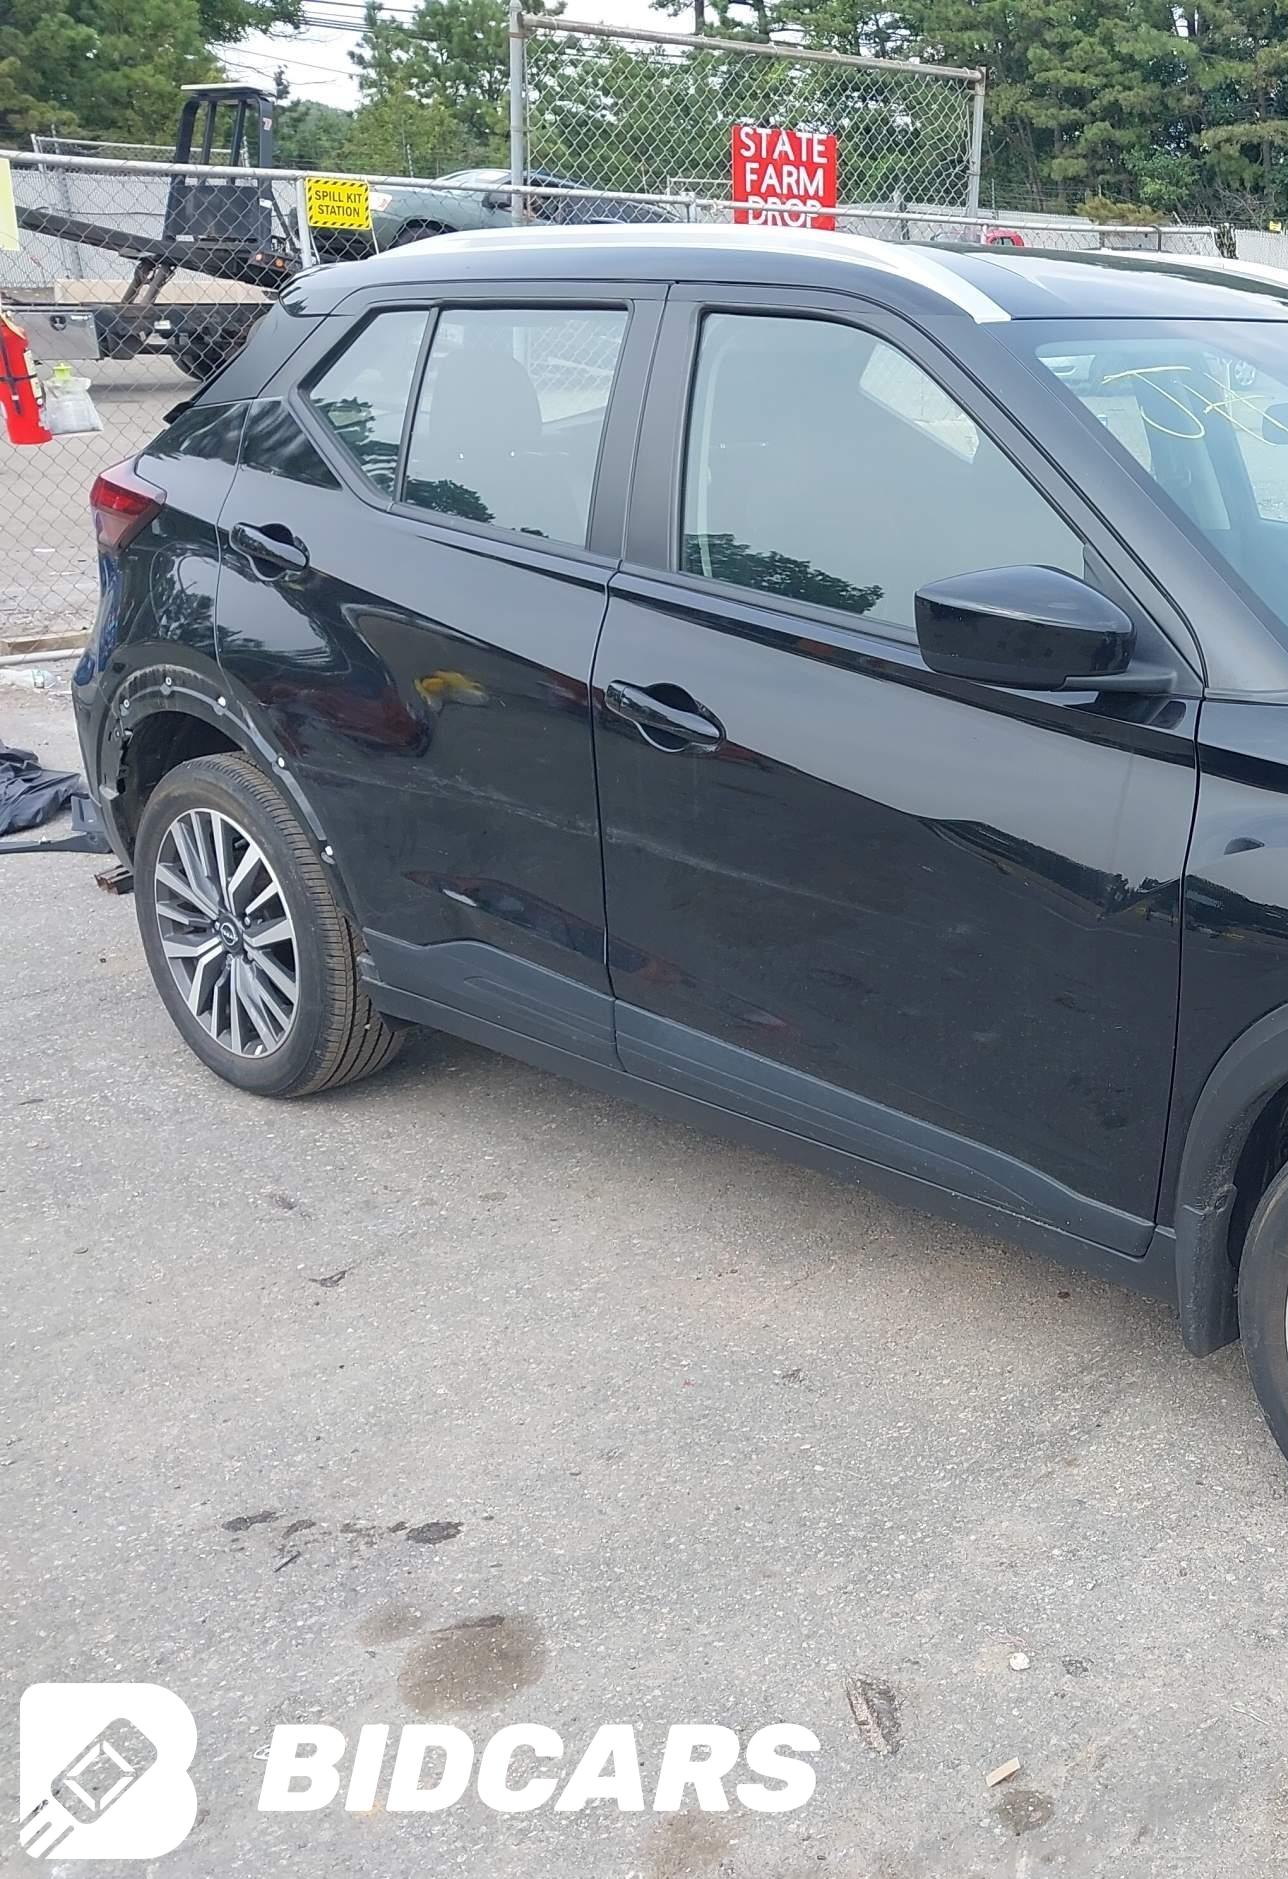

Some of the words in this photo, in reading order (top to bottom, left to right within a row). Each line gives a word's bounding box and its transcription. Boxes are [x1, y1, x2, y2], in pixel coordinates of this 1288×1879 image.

[740, 126, 828, 164] STATE
[745, 161, 824, 197] FARM
[314, 190, 344, 203] SPILL
[346, 192, 362, 204] KIT
[317, 204, 360, 218] STATION
[747, 195, 822, 228] DROP
